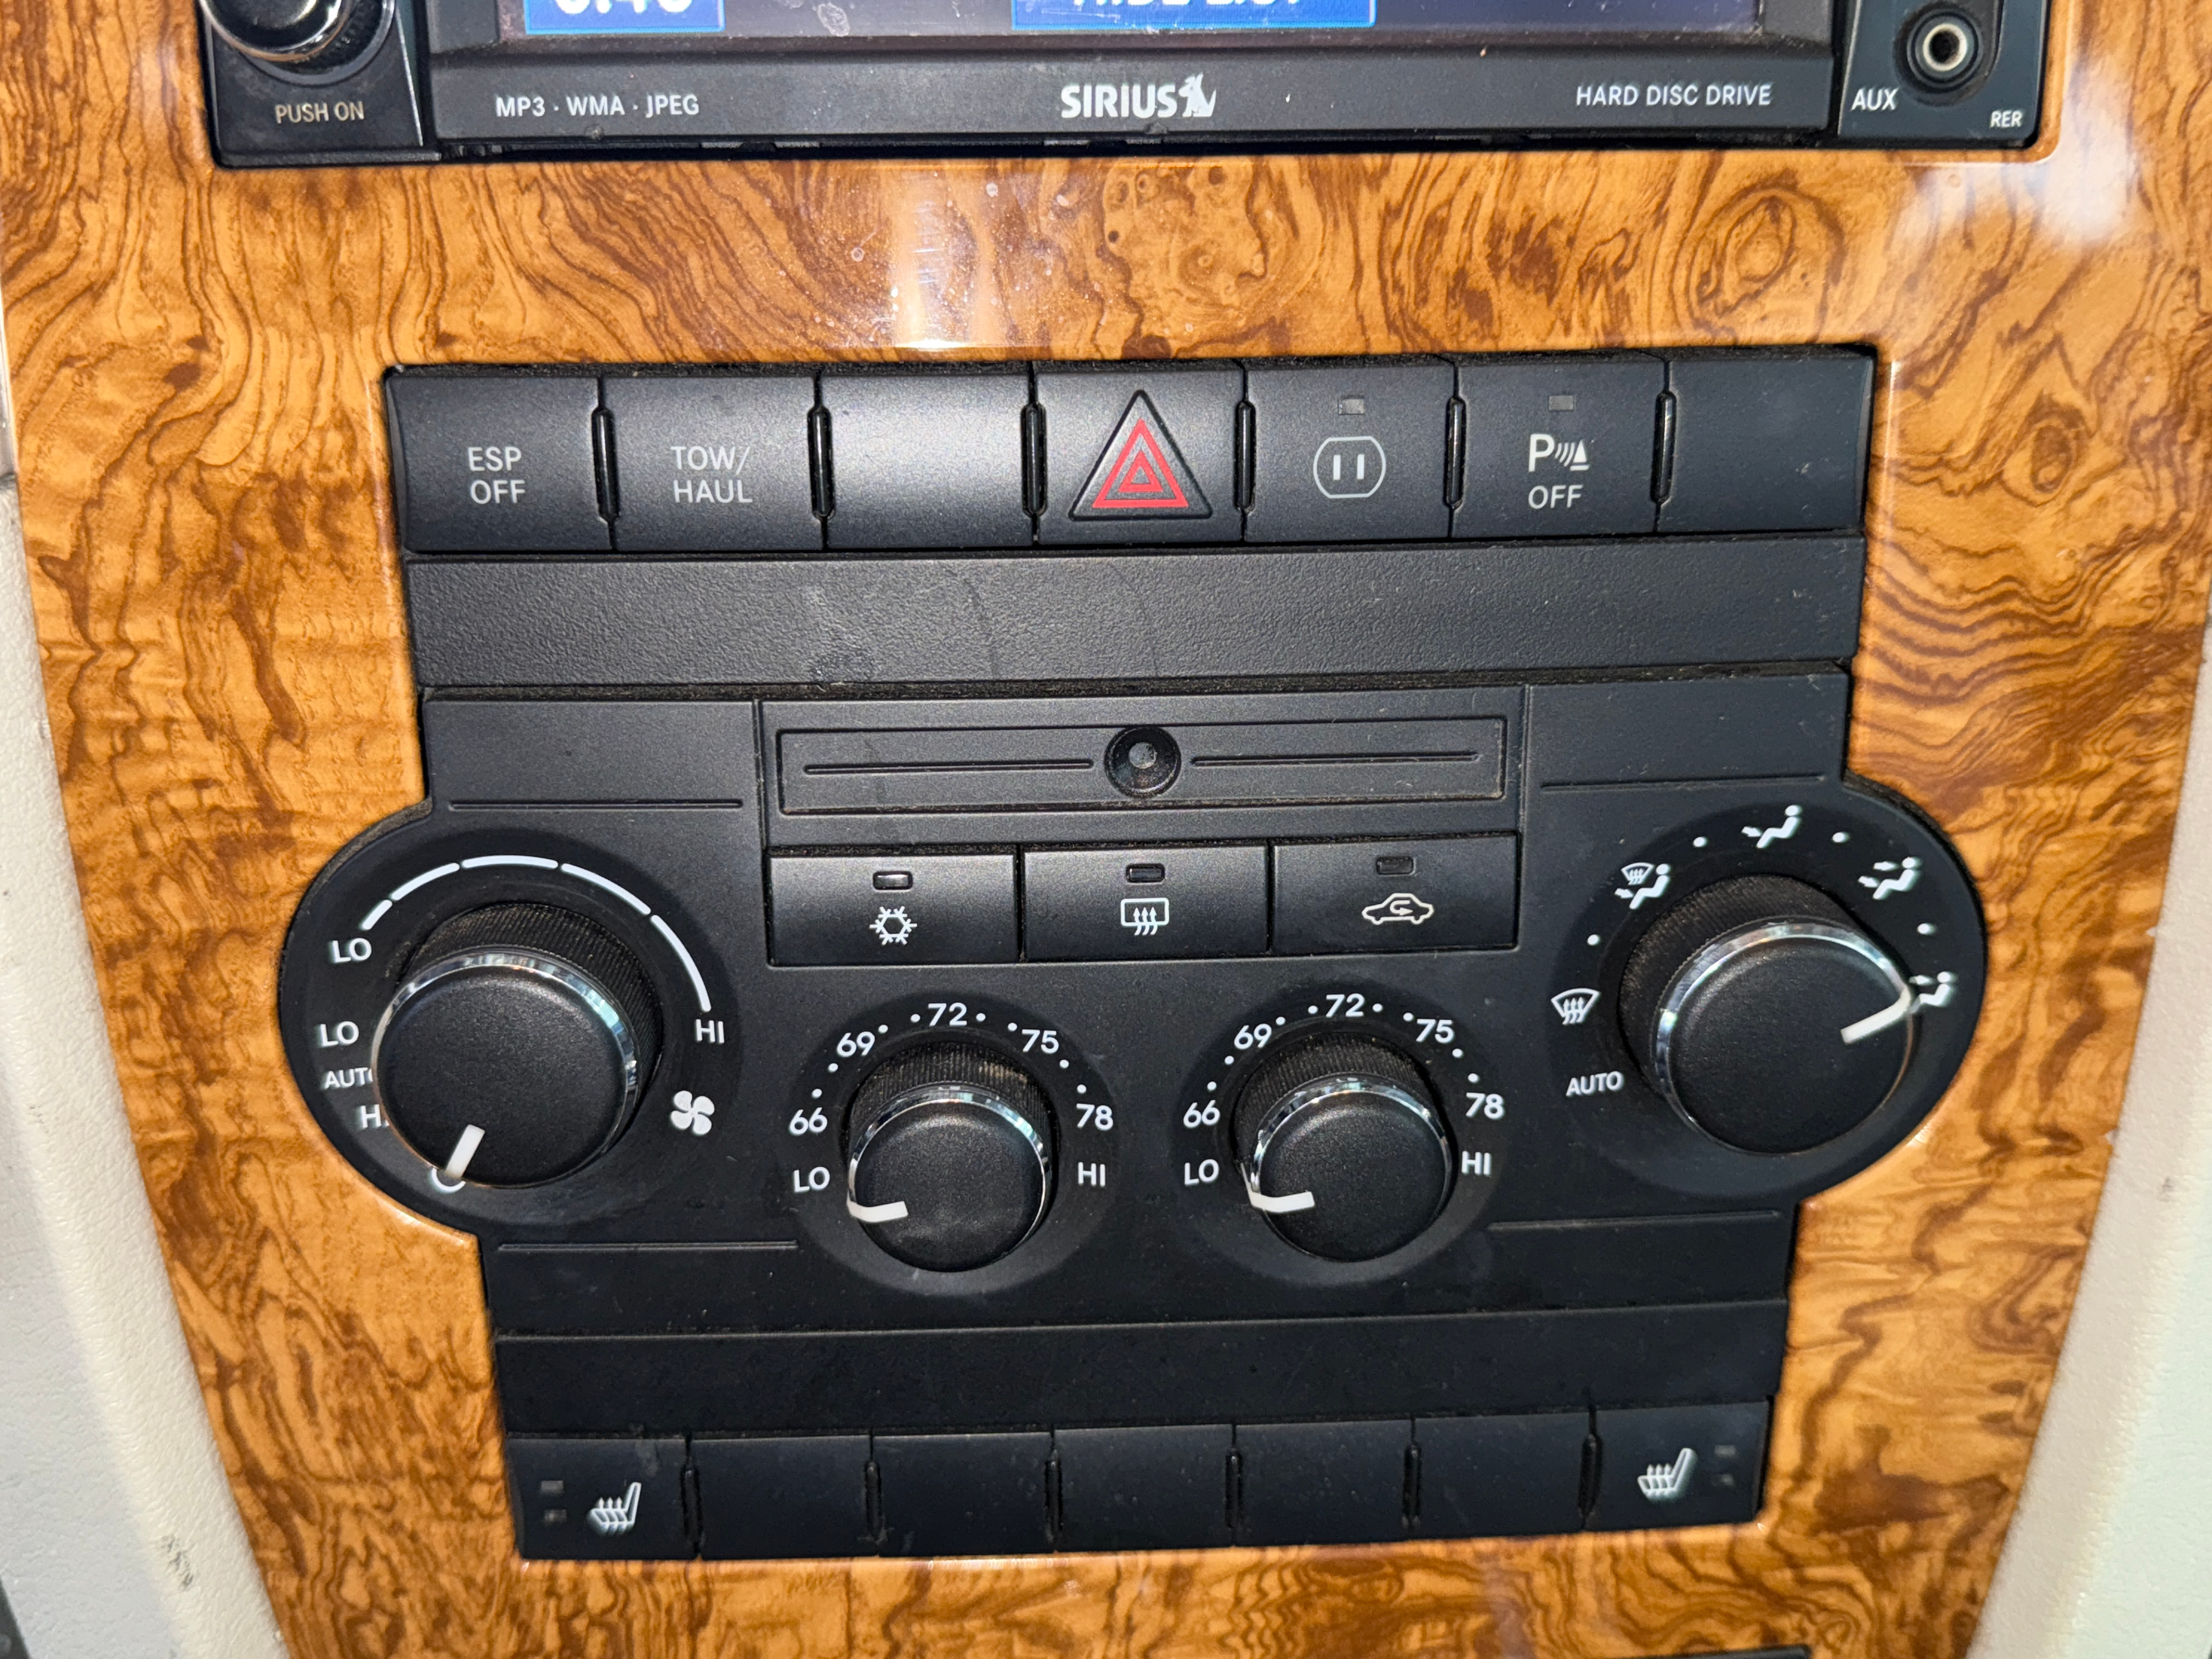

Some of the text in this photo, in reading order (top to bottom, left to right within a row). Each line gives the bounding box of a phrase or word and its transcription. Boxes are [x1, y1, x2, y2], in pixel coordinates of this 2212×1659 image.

[496, 93, 699, 117] MP3 WMA JPEG
[1060, 83, 1177, 119] SIRIUS
[1576, 83, 1771, 106] HARD DISC DRIVE
[1851, 87, 1899, 111] AUX
[275, 100, 365, 124] PUSH ON
[1990, 110, 2023, 128] RER
[467, 446, 522, 472] ESP
[670, 445, 752, 476] TOW/
[470, 479, 526, 504] OFF
[673, 479, 753, 503] HAUL
[1528, 484, 1583, 509] OFF
[331, 938, 372, 964] LO
[928, 1002, 967, 1026] 72
[1325, 993, 1365, 1018] 72
[319, 1021, 359, 1047] LO
[696, 1019, 725, 1044] HI
[1022, 1029, 1059, 1054] 75
[1234, 1023, 1272, 1049] 69
[1416, 1019, 1454, 1043] 75
[837, 1031, 875, 1057] 69
[323, 1066, 374, 1090] AUT
[1566, 1071, 1624, 1097] AUTO
[358, 1104, 390, 1129] H
[1076, 1103, 1114, 1131] 78
[1183, 1099, 1220, 1128] 66
[1465, 1092, 1504, 1119] 78
[789, 1107, 828, 1136] 66
[1078, 1162, 1105, 1187] HI
[1184, 1159, 1219, 1186] LO
[1462, 1150, 1491, 1176] HI
[793, 1166, 830, 1193] LO
